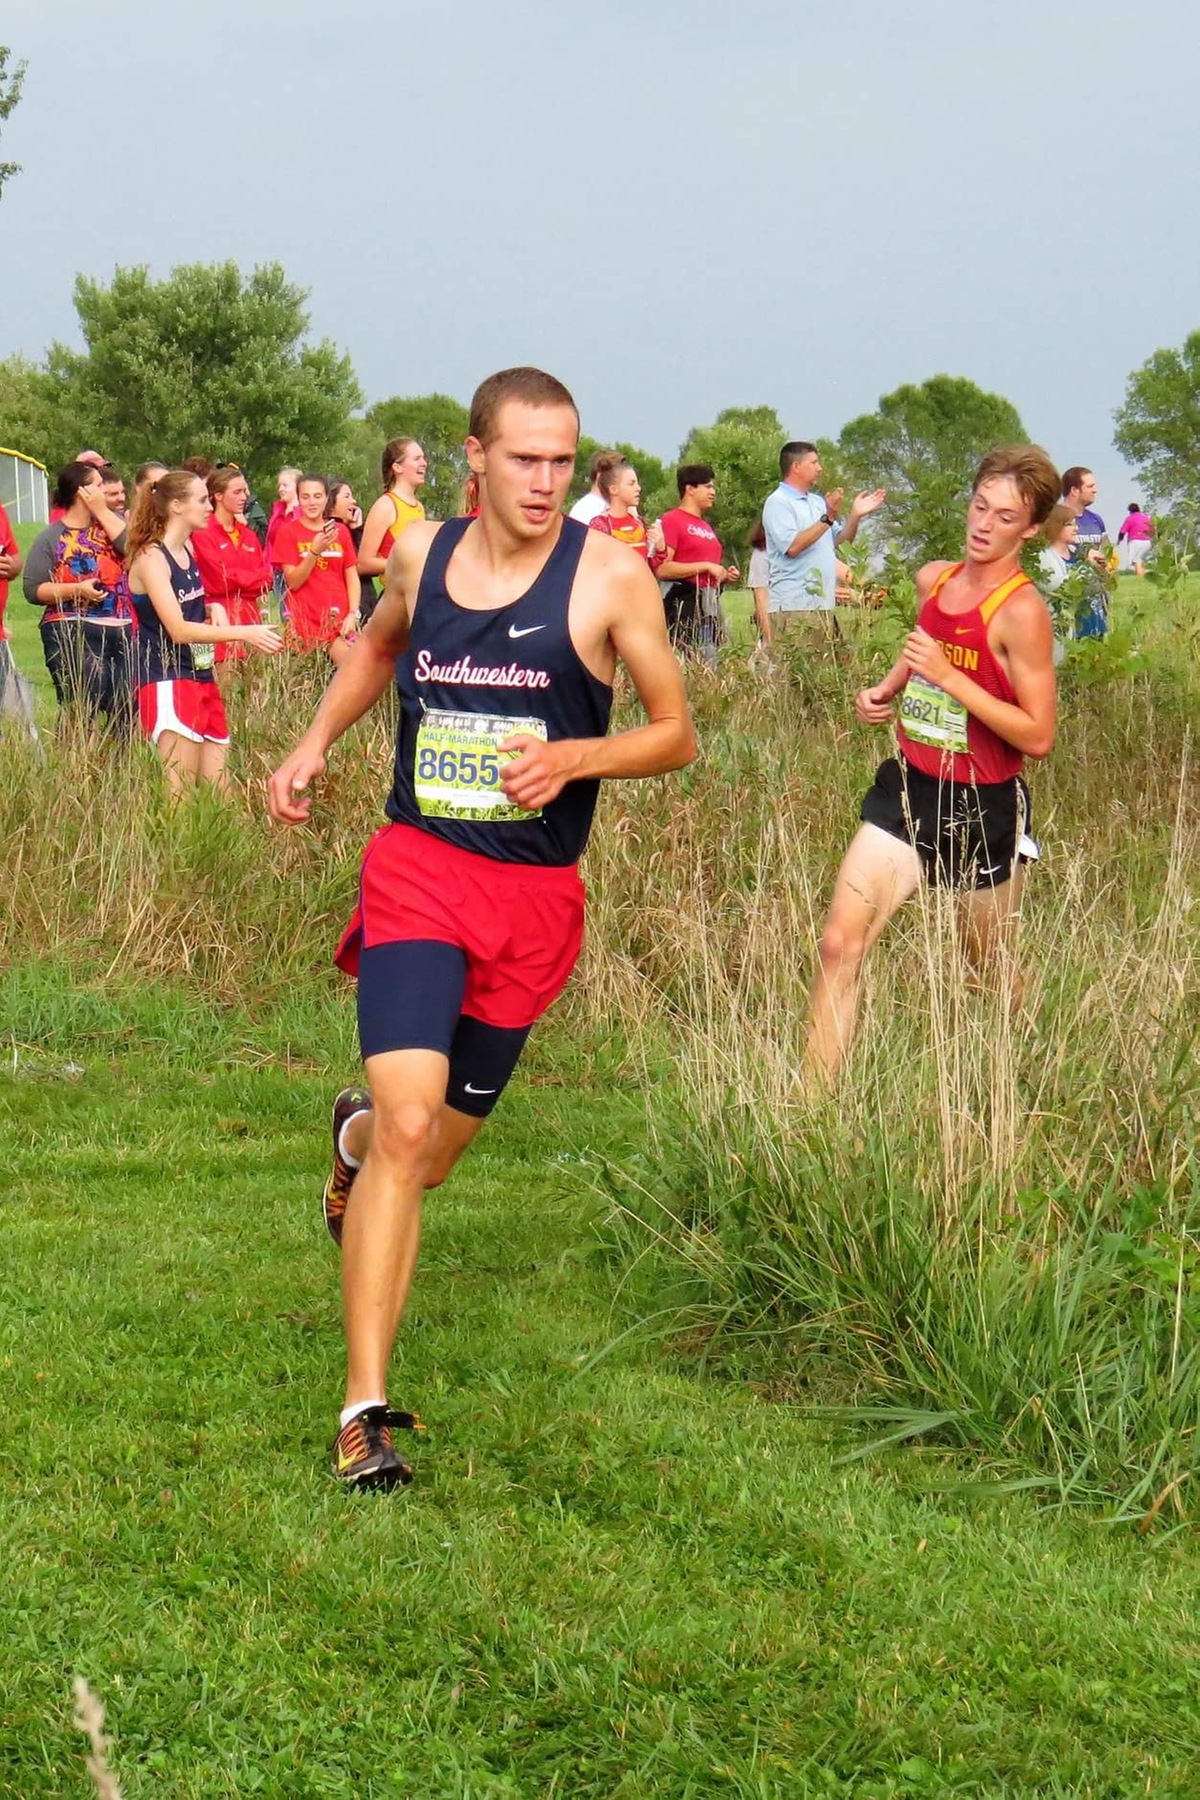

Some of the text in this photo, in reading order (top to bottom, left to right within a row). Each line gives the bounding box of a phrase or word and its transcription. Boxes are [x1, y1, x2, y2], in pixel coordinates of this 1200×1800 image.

[414, 649, 551, 688] Southwestern
[901, 695, 940, 725] 8621
[423, 730, 498, 747] HALF-MARATHON
[418, 748, 499, 786] 8655
